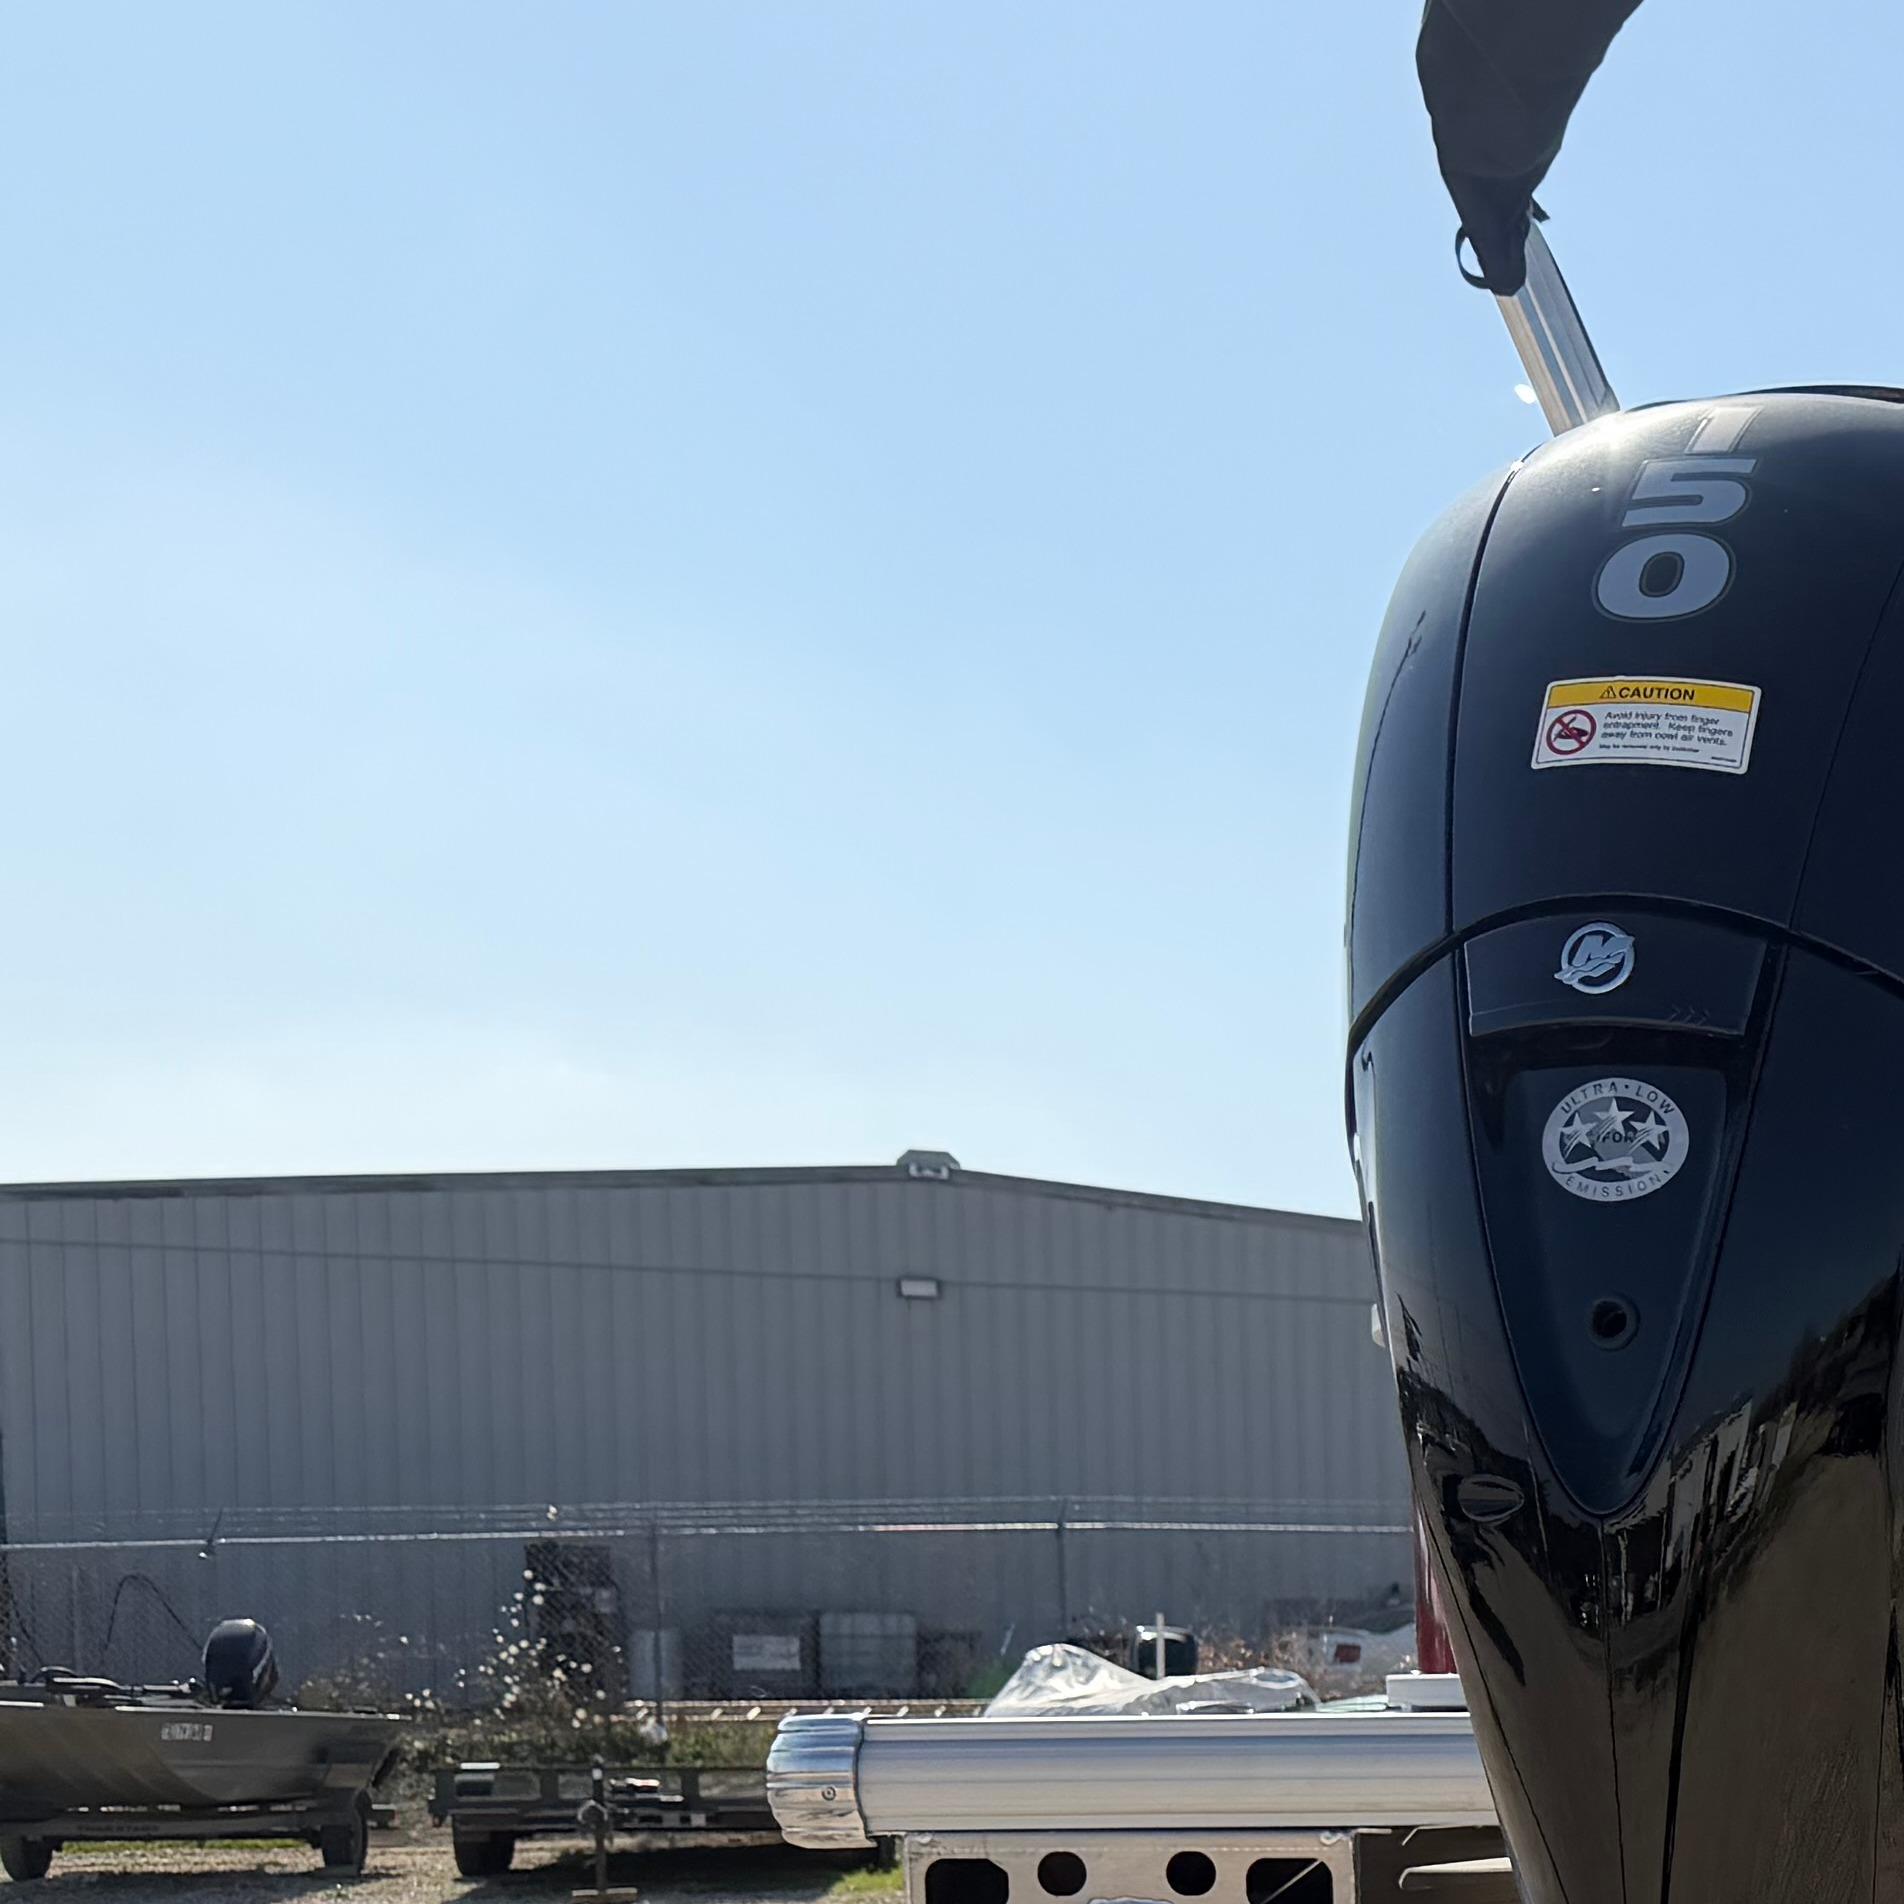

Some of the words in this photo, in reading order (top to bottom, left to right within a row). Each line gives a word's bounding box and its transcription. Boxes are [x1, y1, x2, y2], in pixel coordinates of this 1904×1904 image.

[1618, 687, 1695, 701] CAUTION
[1604, 711, 1632, 720] Avoid
[1665, 712, 1688, 721] from
[1668, 722, 1695, 734] Keep
[1601, 730, 1627, 740] away
[1560, 1081, 1618, 1114] ULTRA
[1635, 1084, 1675, 1115] LOW
[1565, 1174, 1662, 1198] EMISSION
